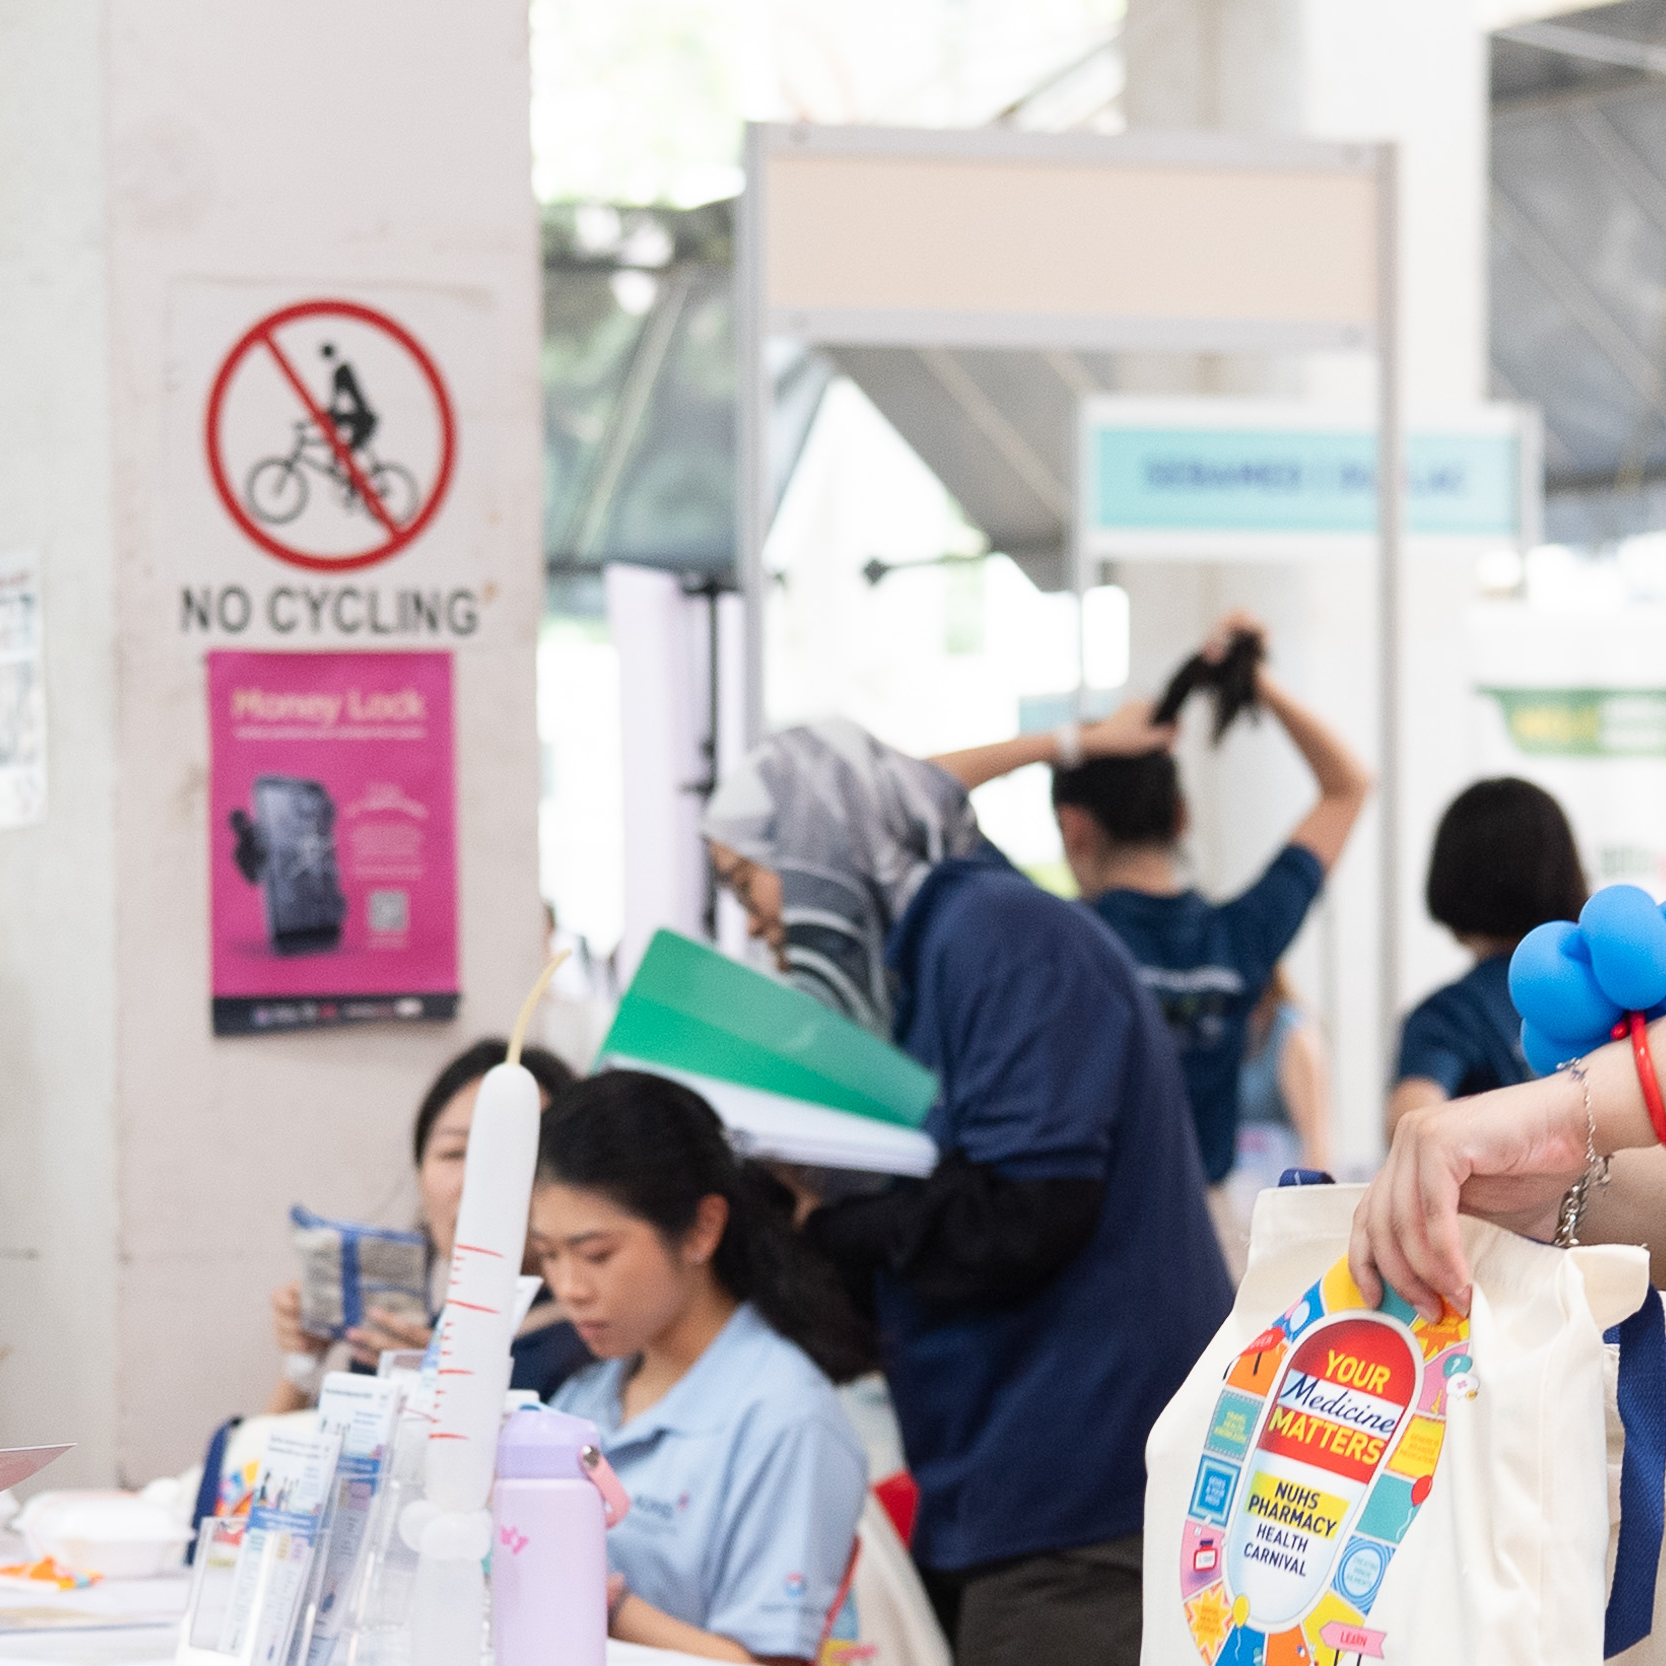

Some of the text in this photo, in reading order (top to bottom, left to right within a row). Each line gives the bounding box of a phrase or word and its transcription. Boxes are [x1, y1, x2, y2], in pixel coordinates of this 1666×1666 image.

[180, 585, 478, 637] NO CYCLING
[1325, 1349, 1391, 1394] YOUR
[1278, 1373, 1396, 1434] Medicine
[1268, 1409, 1385, 1465] MATTERS
[1248, 1494, 1338, 1538] PHARMACY
[1274, 1481, 1321, 1511] NUHS
[1243, 1542, 1307, 1577] CARNIVAL
[1256, 1523, 1309, 1553] HEALTH
[1339, 1631, 1368, 1648] LEARN
